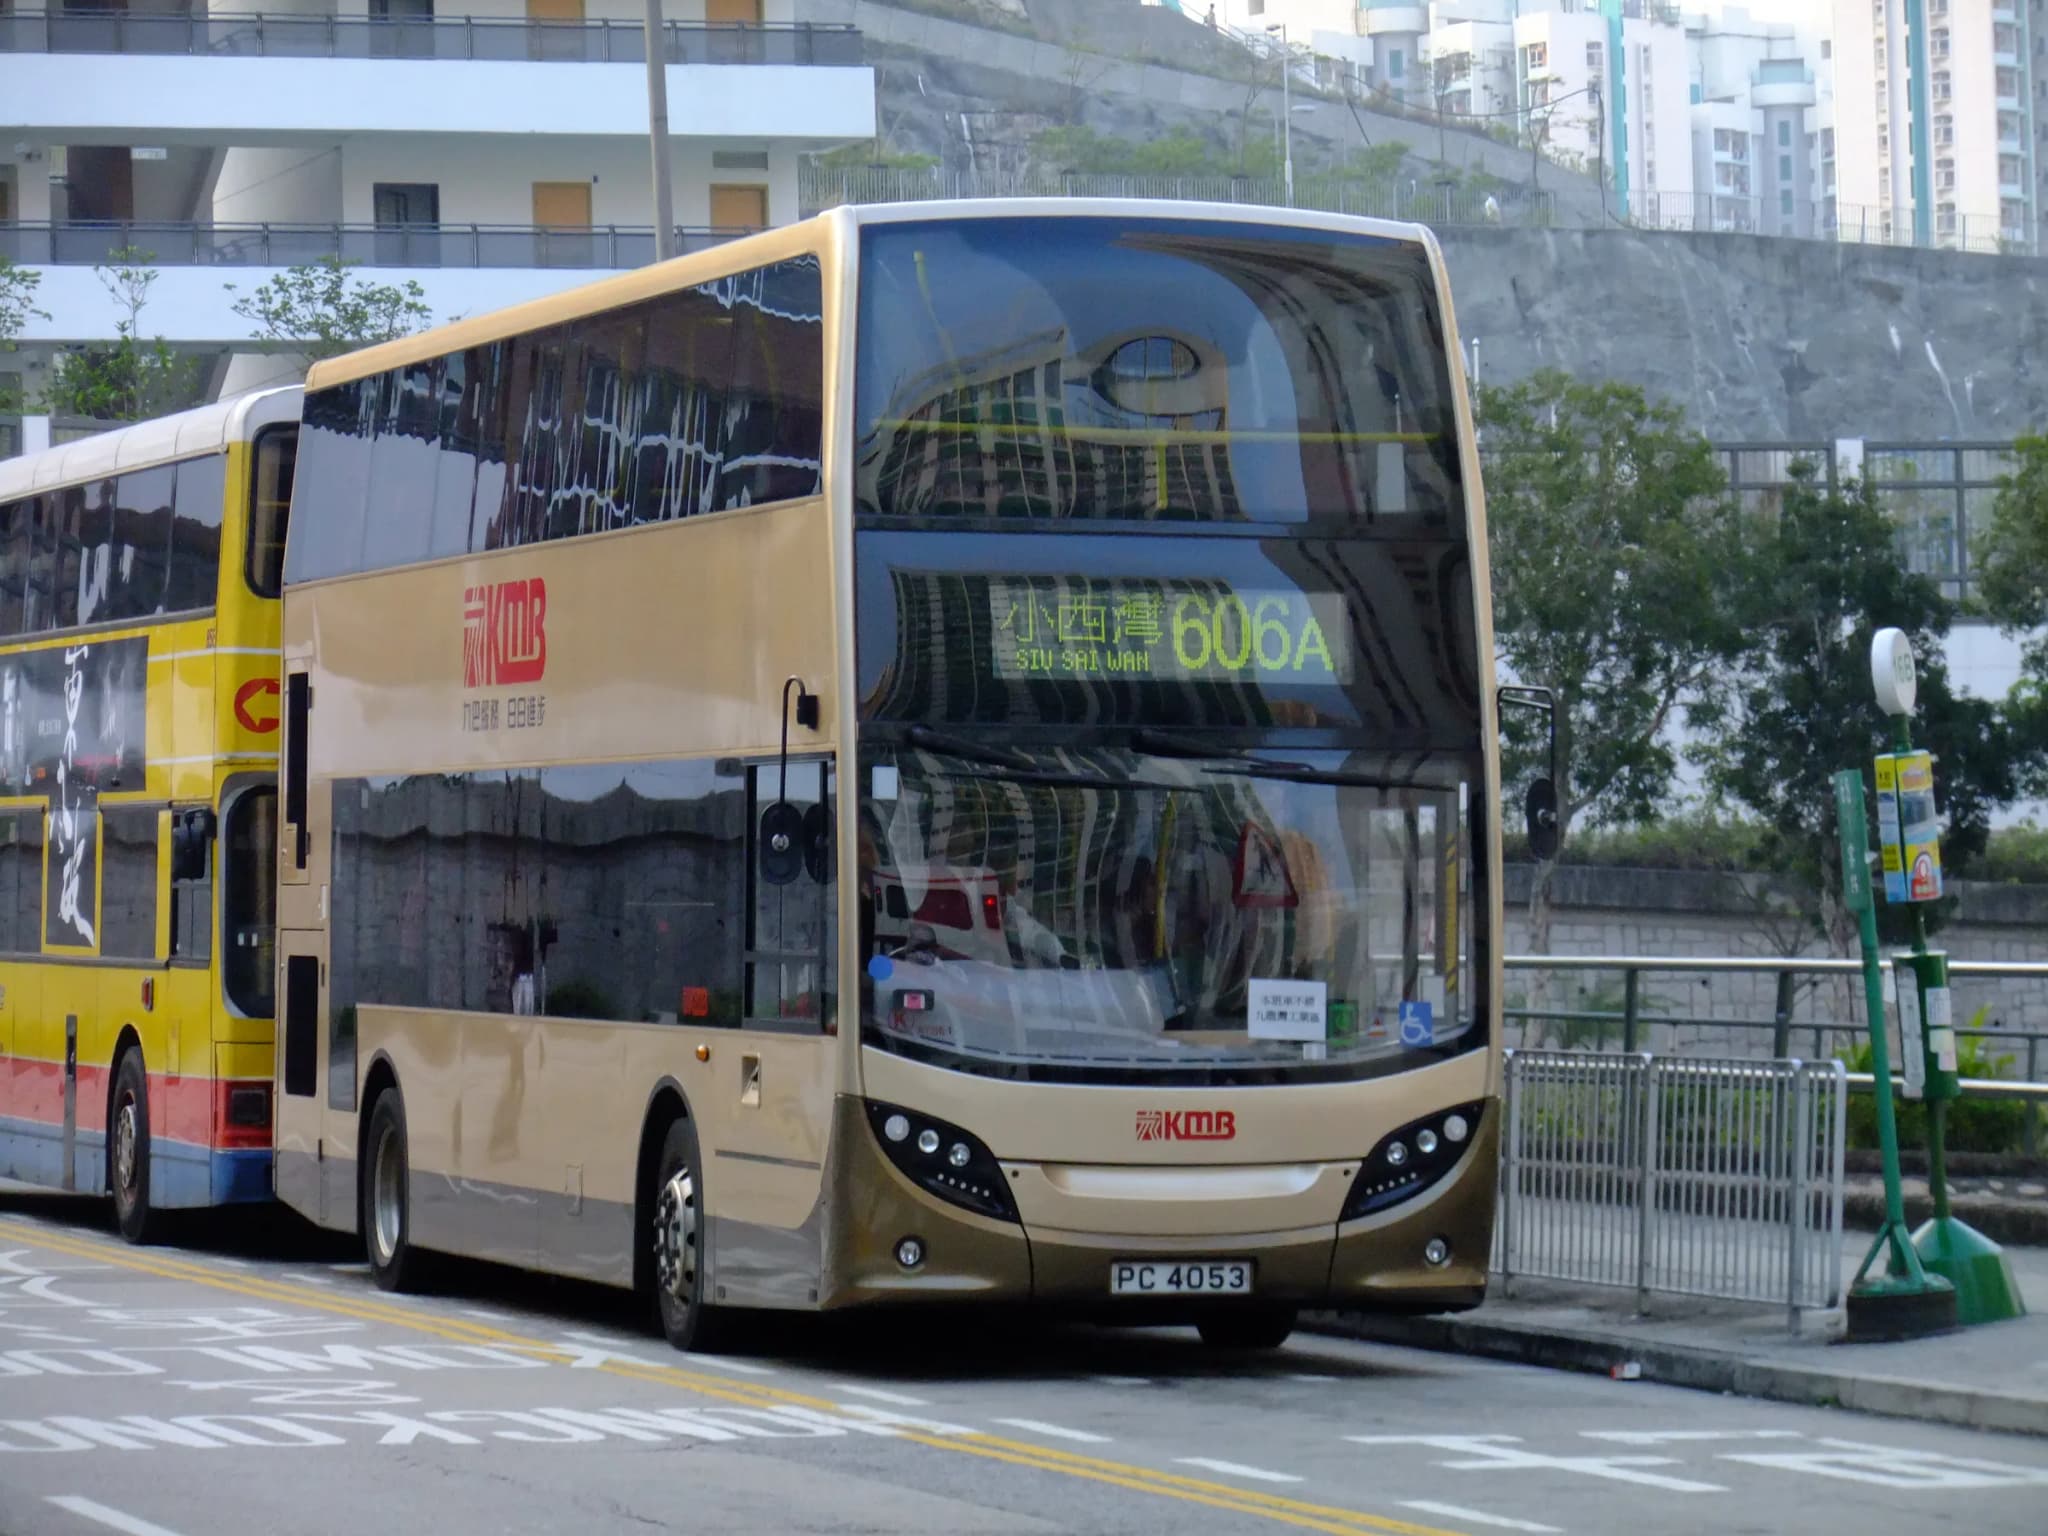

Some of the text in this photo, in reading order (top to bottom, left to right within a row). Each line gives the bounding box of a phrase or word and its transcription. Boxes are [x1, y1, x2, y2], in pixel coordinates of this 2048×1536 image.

[485, 577, 546, 686] KMB
[1000, 588, 1164, 645] 小西灣
[1173, 595, 1335, 671] 606A
[1016, 649, 1150, 672] SIU SAI WAN
[507, 696, 546, 729] 日日進步
[1164, 1110, 1236, 1141] KMB
[1117, 1266, 1245, 1290] PC 4053
[492, 1405, 986, 1443] HONG
